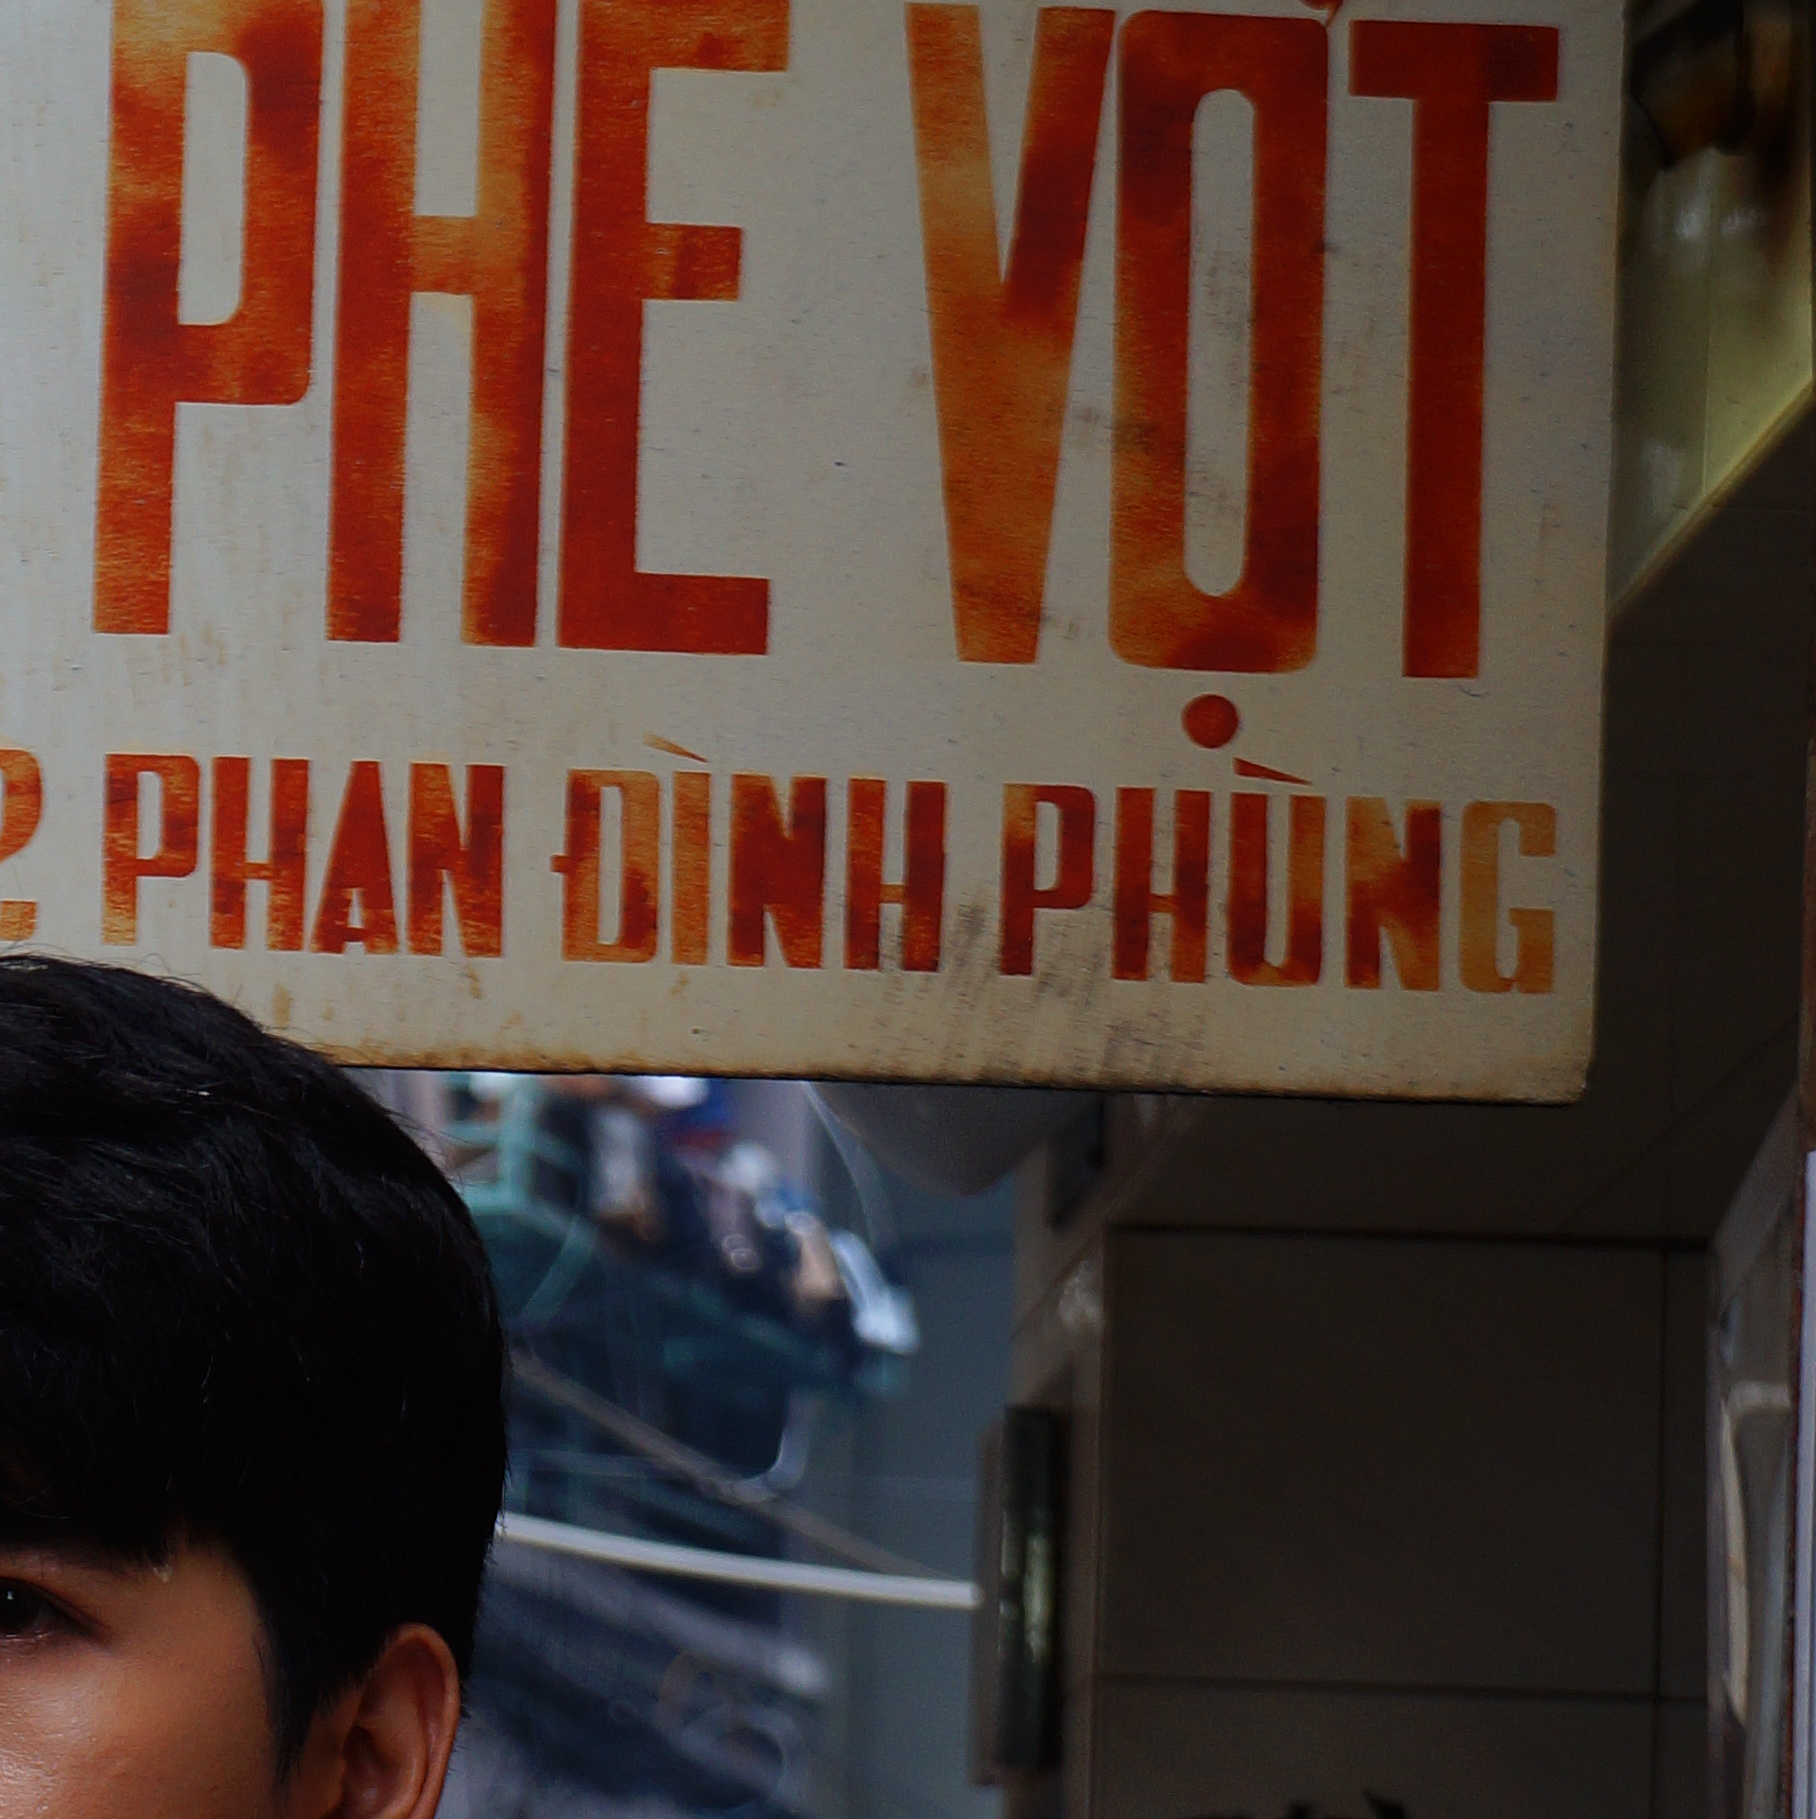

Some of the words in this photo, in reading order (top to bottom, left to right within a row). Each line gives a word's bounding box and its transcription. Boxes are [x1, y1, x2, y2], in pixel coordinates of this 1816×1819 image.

[99, 750, 506, 960] PHAN
[551, 731, 947, 975] ĐÌNH
[1002, 756, 1559, 996] PHÙNG
